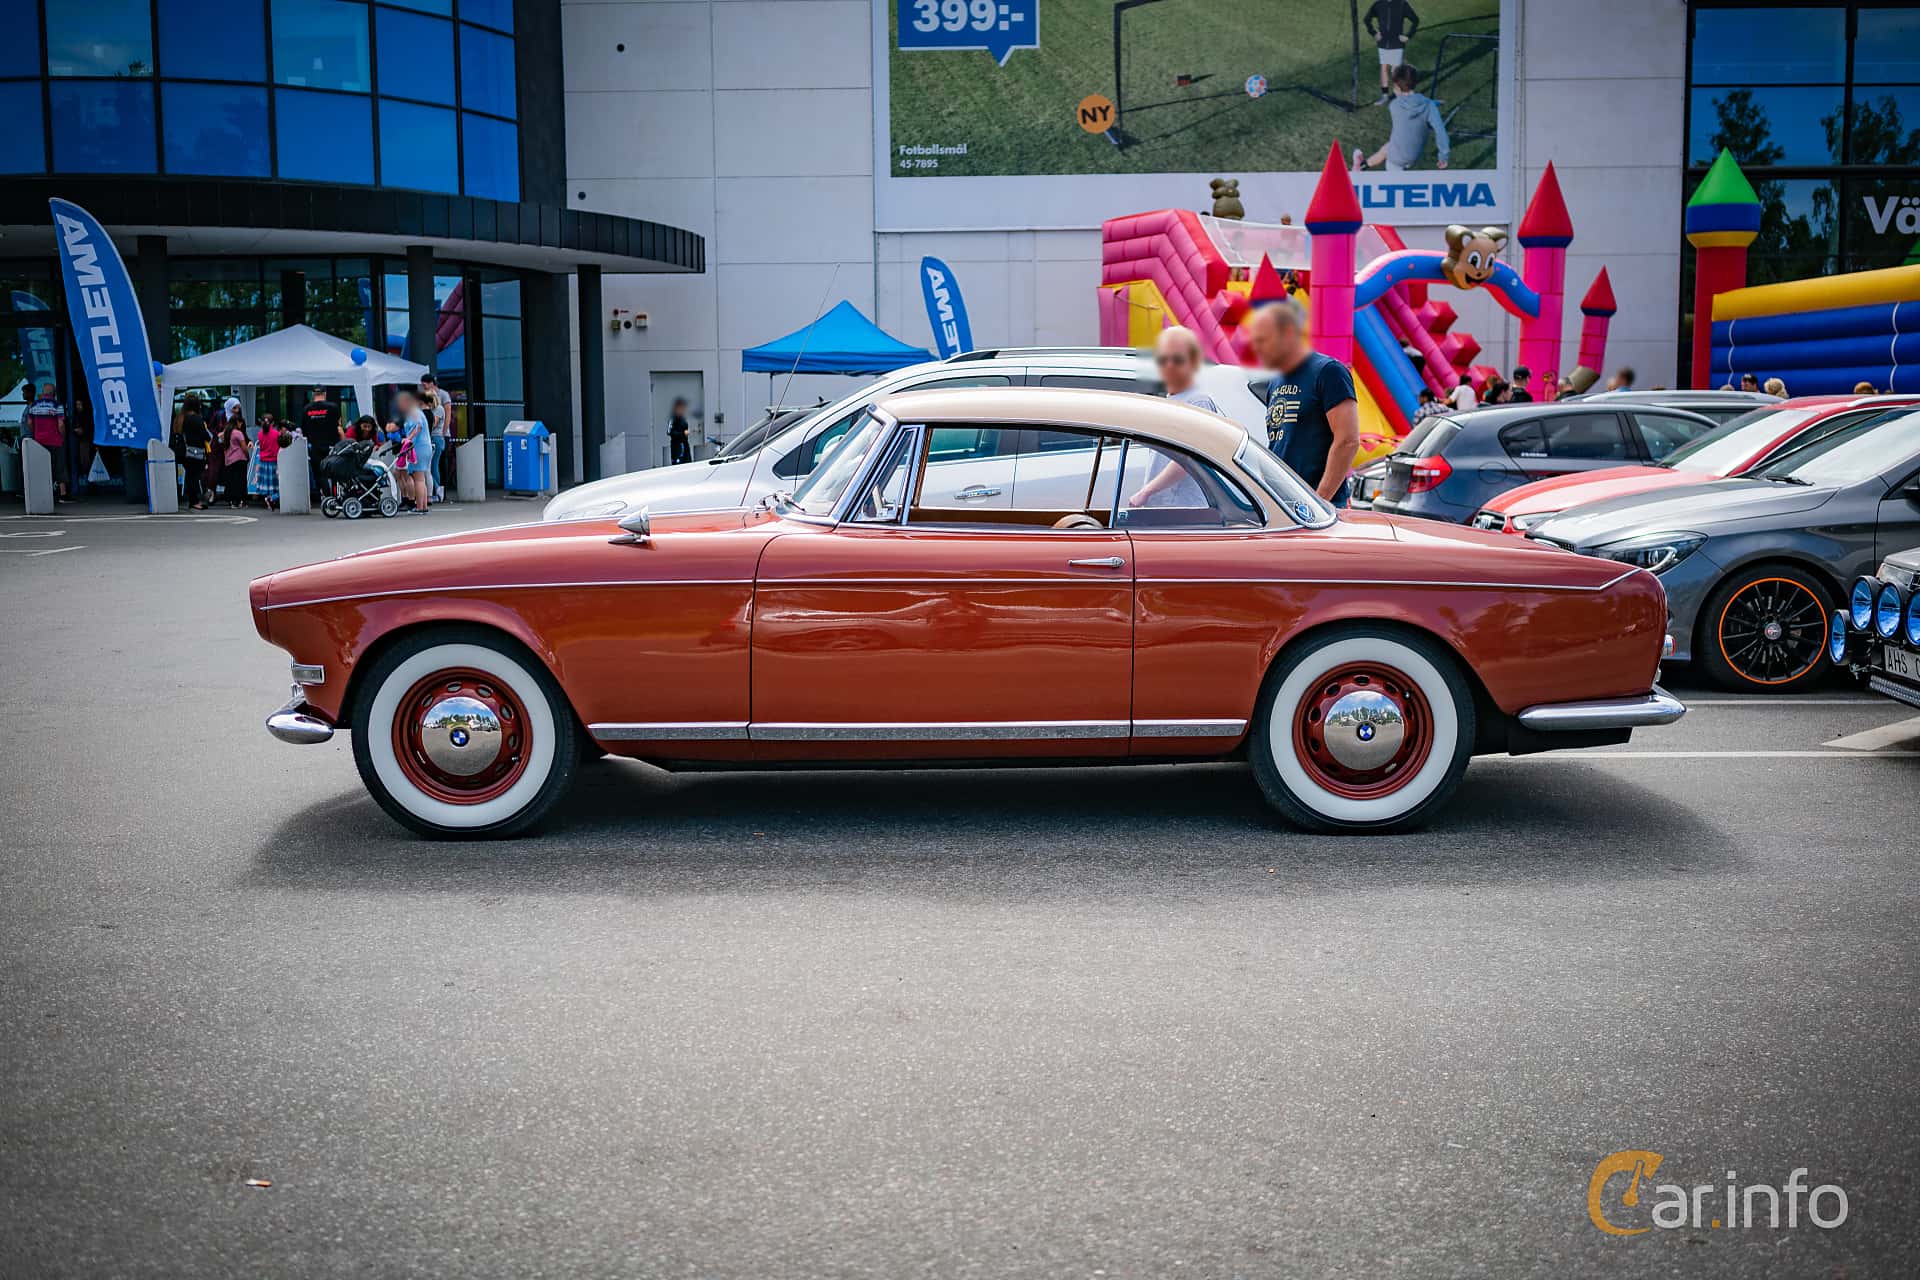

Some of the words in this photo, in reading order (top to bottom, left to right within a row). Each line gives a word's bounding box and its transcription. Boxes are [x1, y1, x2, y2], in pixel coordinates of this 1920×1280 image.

[912, 0, 1025, 32] 399:-
[1080, 104, 1111, 125] NY
[899, 143, 968, 155] Fotbollsmål
[899, 159, 939, 168] 45-7895
[1354, 183, 1496, 208] LTEMA
[1888, 647, 1908, 674] AHS
